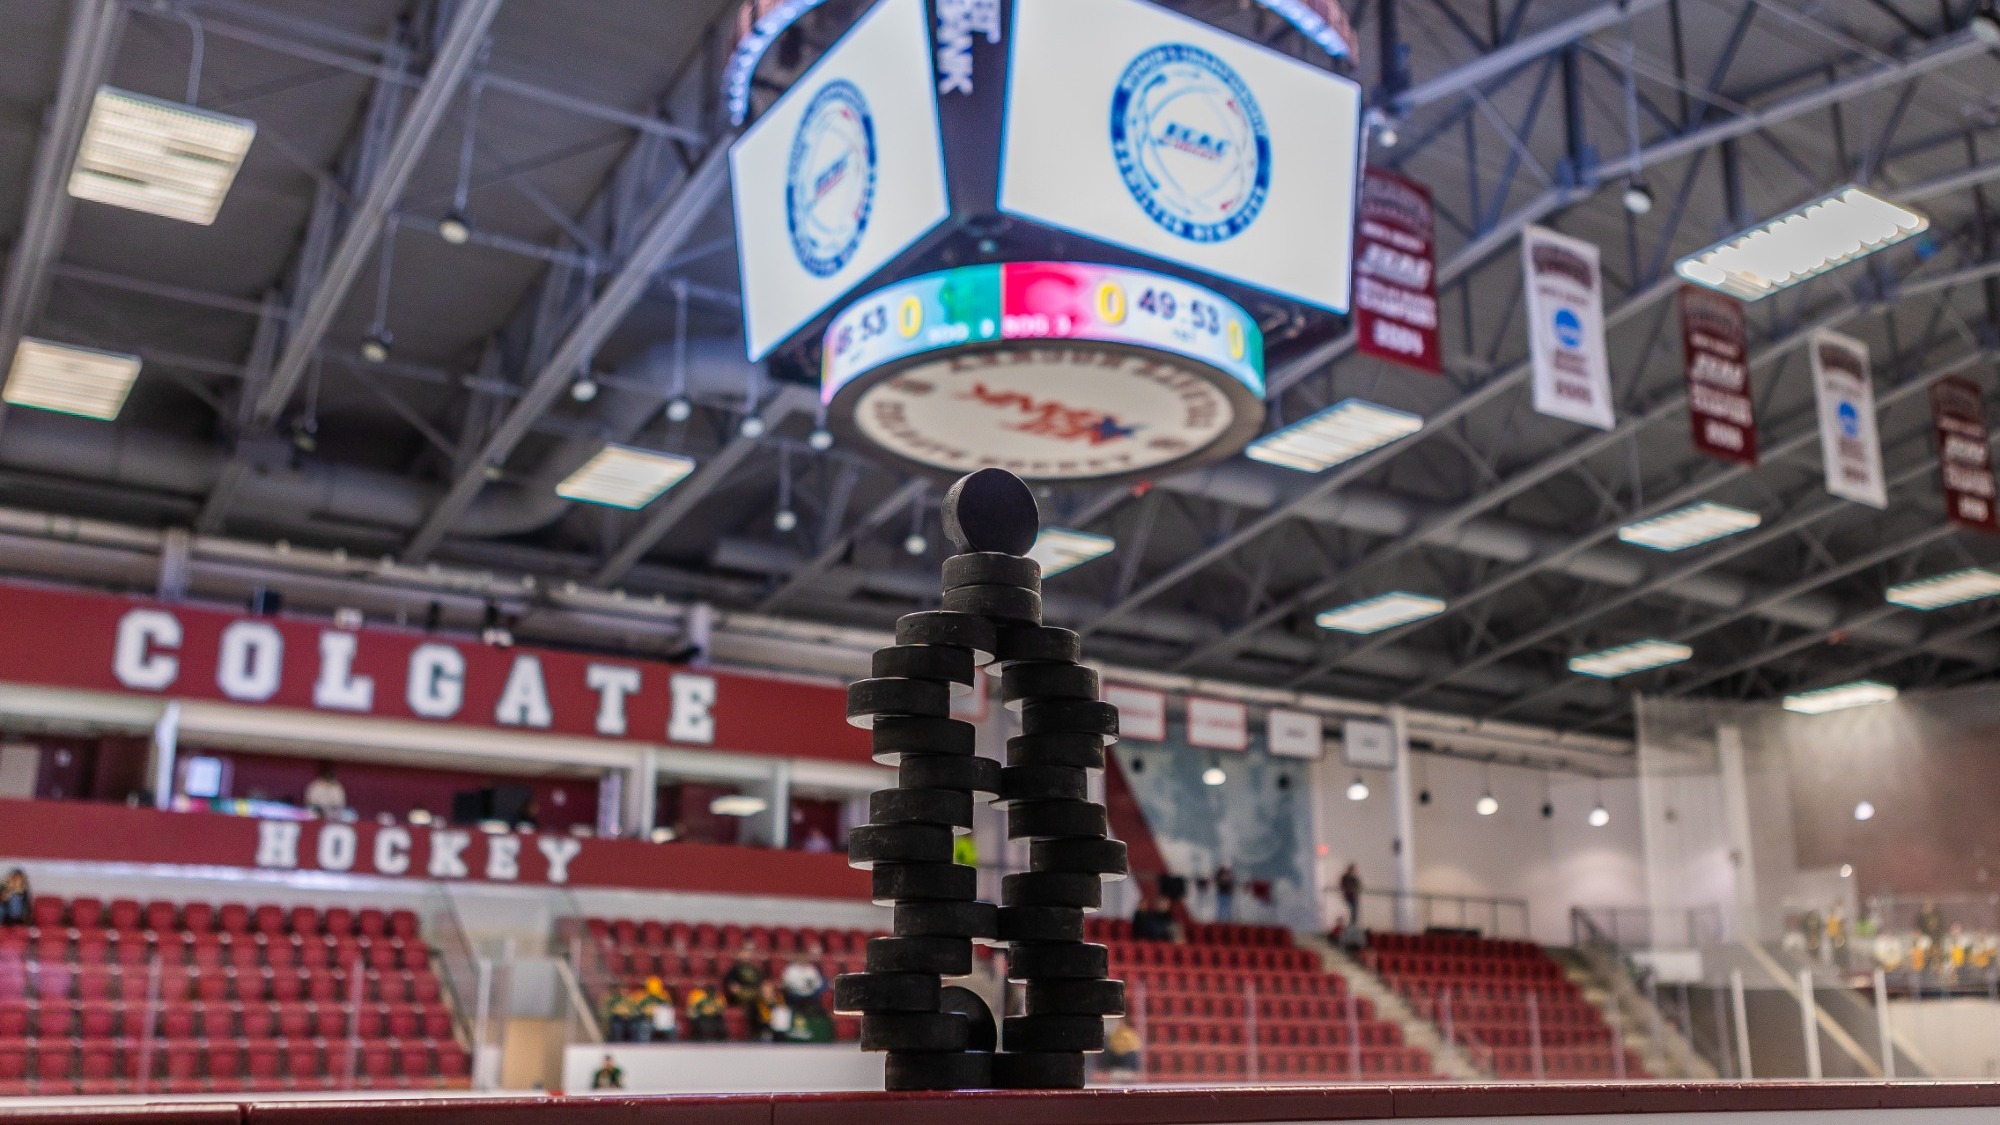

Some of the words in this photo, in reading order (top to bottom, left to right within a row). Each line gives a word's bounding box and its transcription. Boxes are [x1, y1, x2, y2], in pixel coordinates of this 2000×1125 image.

[898, 295, 923, 338] 0
[1097, 281, 1126, 325] 0
[1138, 287, 1220, 335] 49:53
[113, 608, 717, 745] COLGATE
[256, 819, 582, 884] HOCKEY
